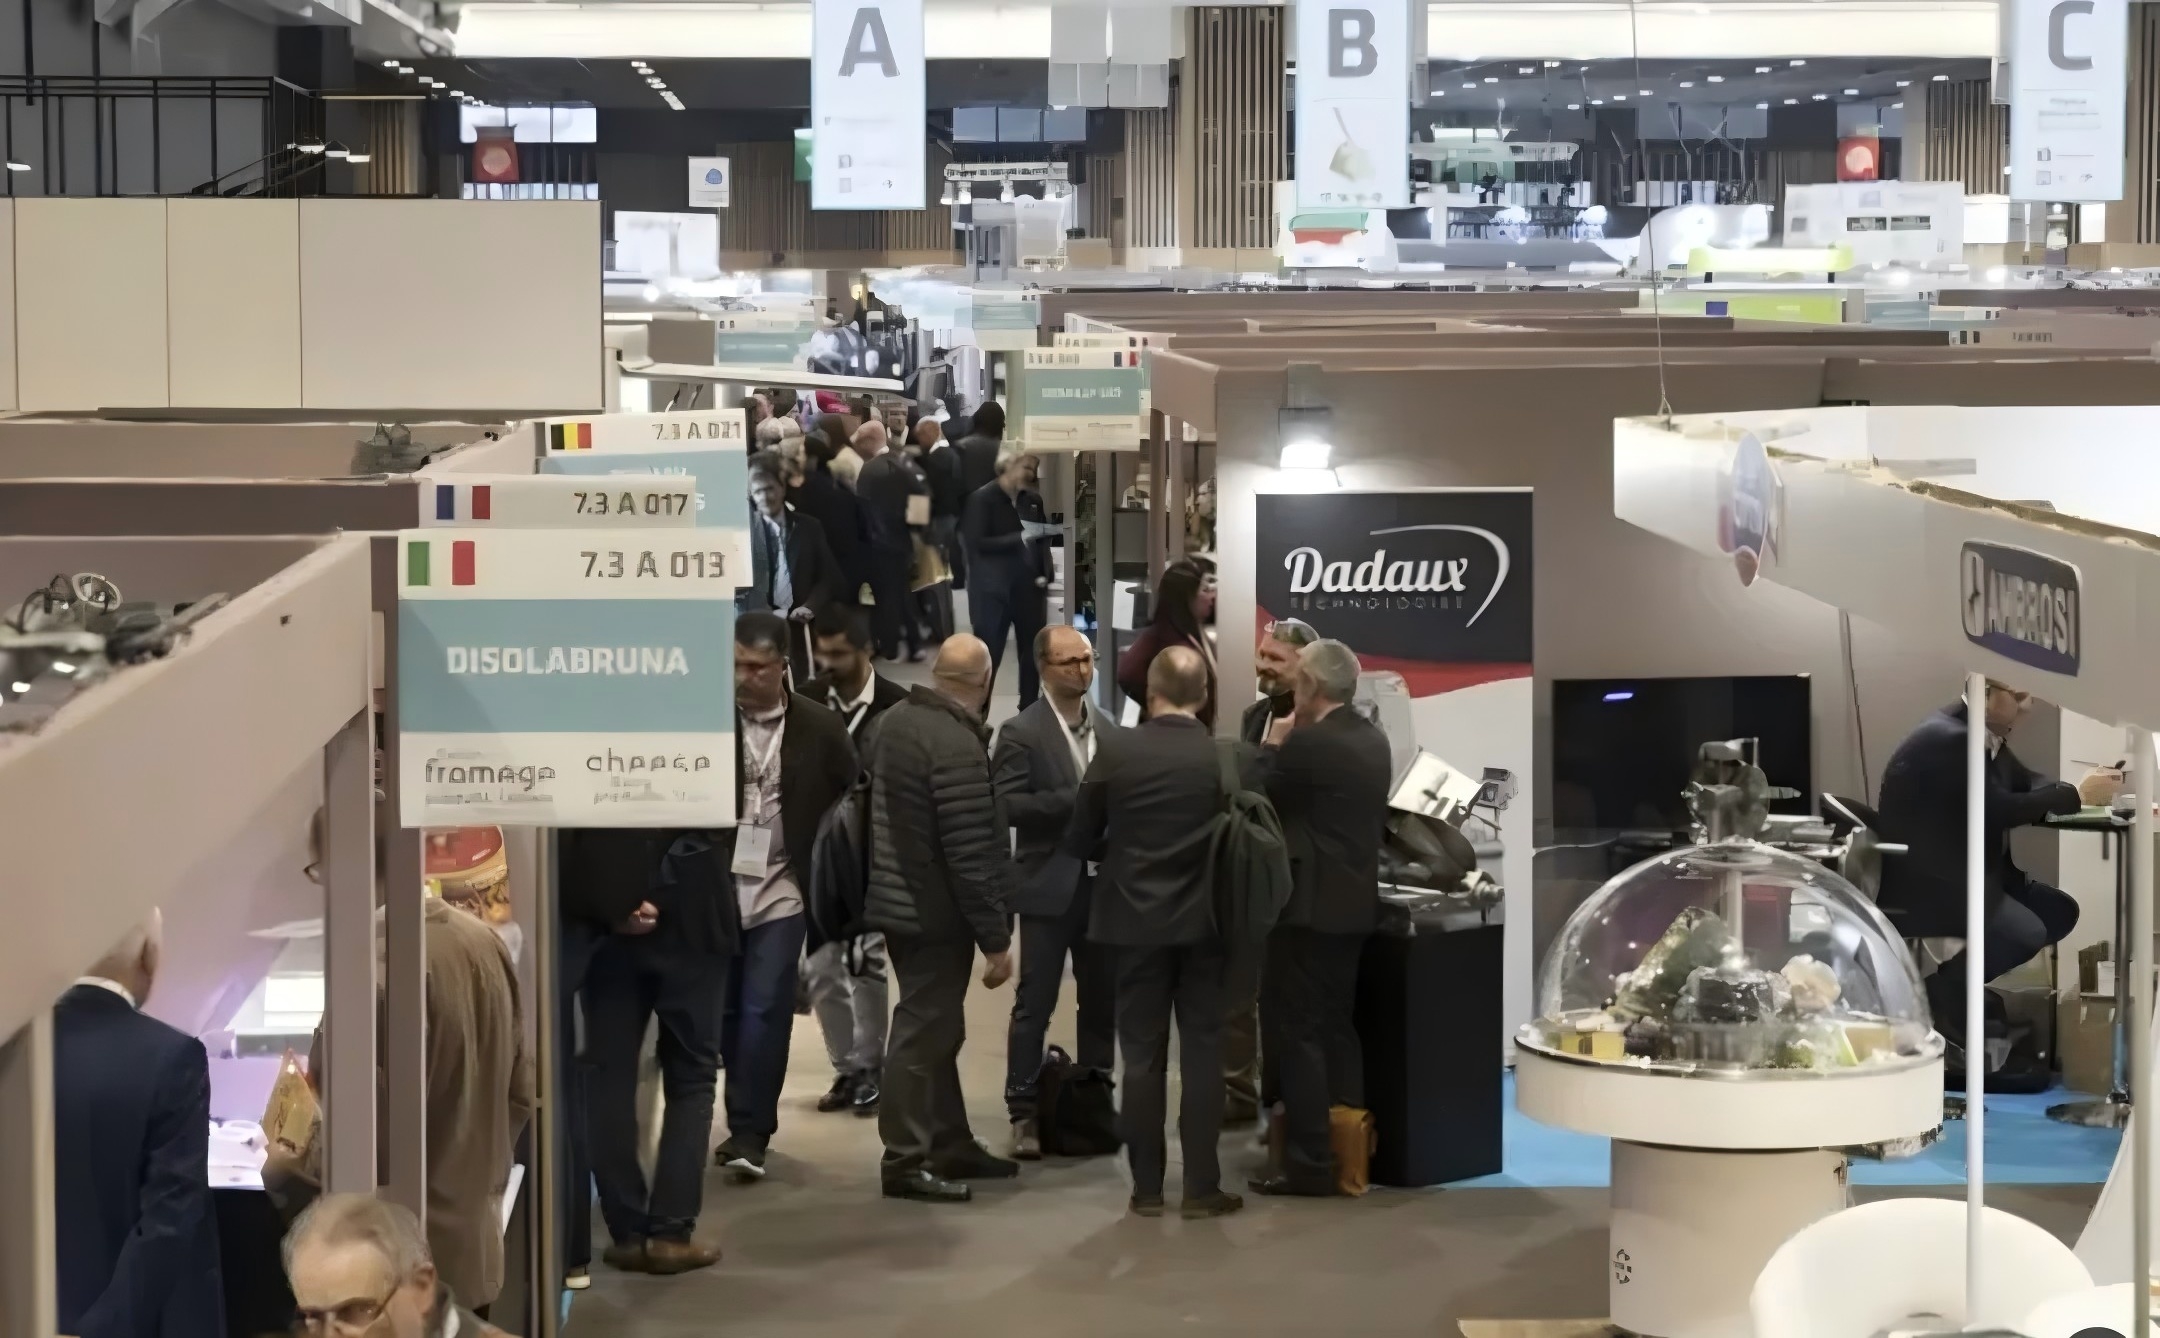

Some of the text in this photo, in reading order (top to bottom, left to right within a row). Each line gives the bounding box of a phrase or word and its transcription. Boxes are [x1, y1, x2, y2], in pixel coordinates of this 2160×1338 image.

[838, 7, 900, 78] A
[1328, 8, 1379, 78] B
[2048, 0, 2096, 71] C
[687, 421, 702, 440] A
[573, 492, 610, 515] 7.3
[617, 491, 637, 515] A
[644, 493, 689, 516] 017
[579, 550, 726, 578] 7.3 A 013
[1284, 546, 1468, 594] Dadaux
[1986, 567, 2077, 660] AMBROSI
[446, 646, 691, 676] DISOLABRUNA
